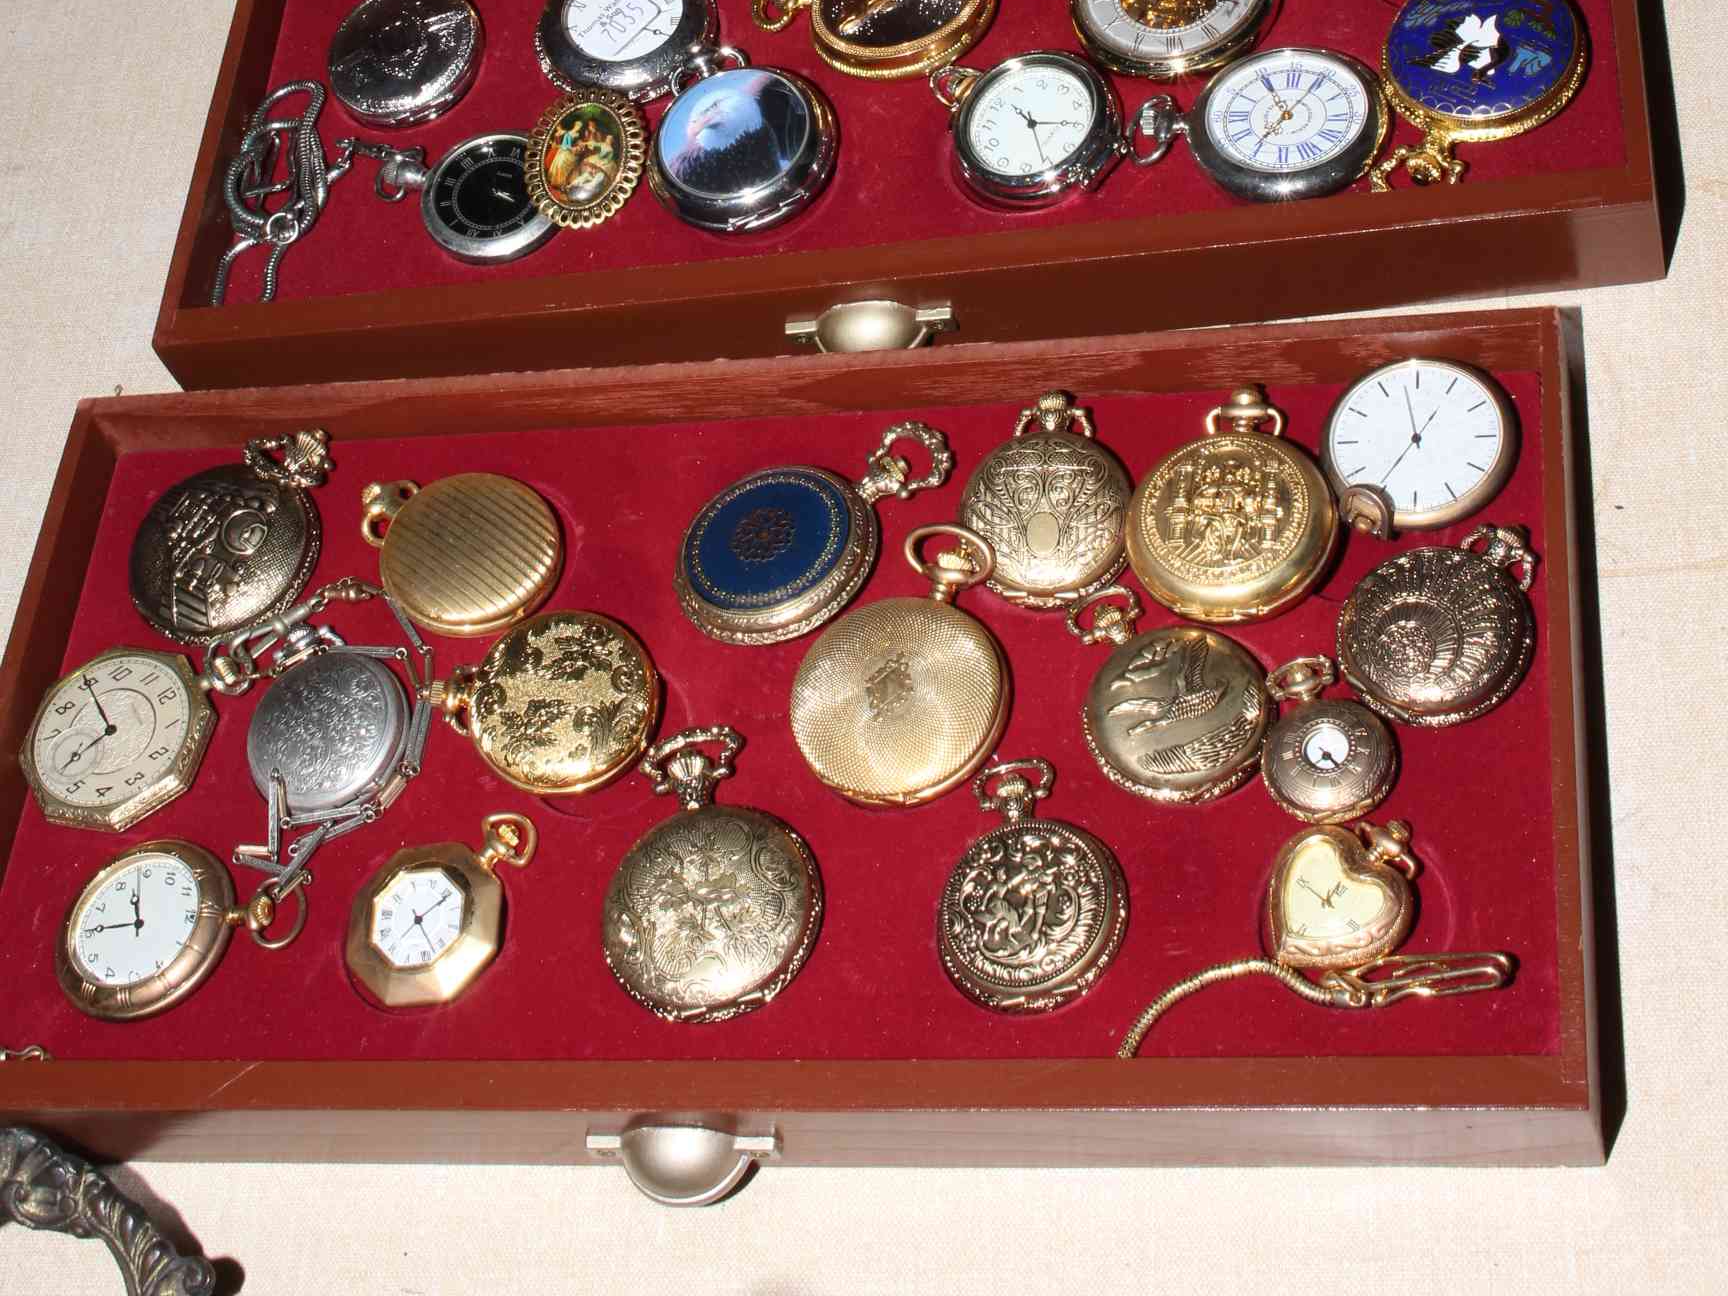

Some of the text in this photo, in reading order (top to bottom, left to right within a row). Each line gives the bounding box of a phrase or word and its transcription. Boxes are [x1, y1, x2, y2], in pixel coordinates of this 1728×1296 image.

[600, 2, 645, 42] 7035
[990, 97, 1006, 112] 12
[982, 119, 997, 130] 11
[983, 137, 1000, 152] 10
[108, 665, 133, 682] 10
[140, 672, 160, 686] 11
[157, 687, 177, 705] 12
[55, 701, 76, 715] 8
[148, 746, 169, 760] 2
[124, 771, 145, 786] 3
[66, 779, 86, 794] 5
[96, 786, 113, 798] 4
[165, 871, 177, 886] 10
[115, 881, 127, 892] 8
[181, 885, 193, 897] 11
[184, 909, 197, 925] 12
